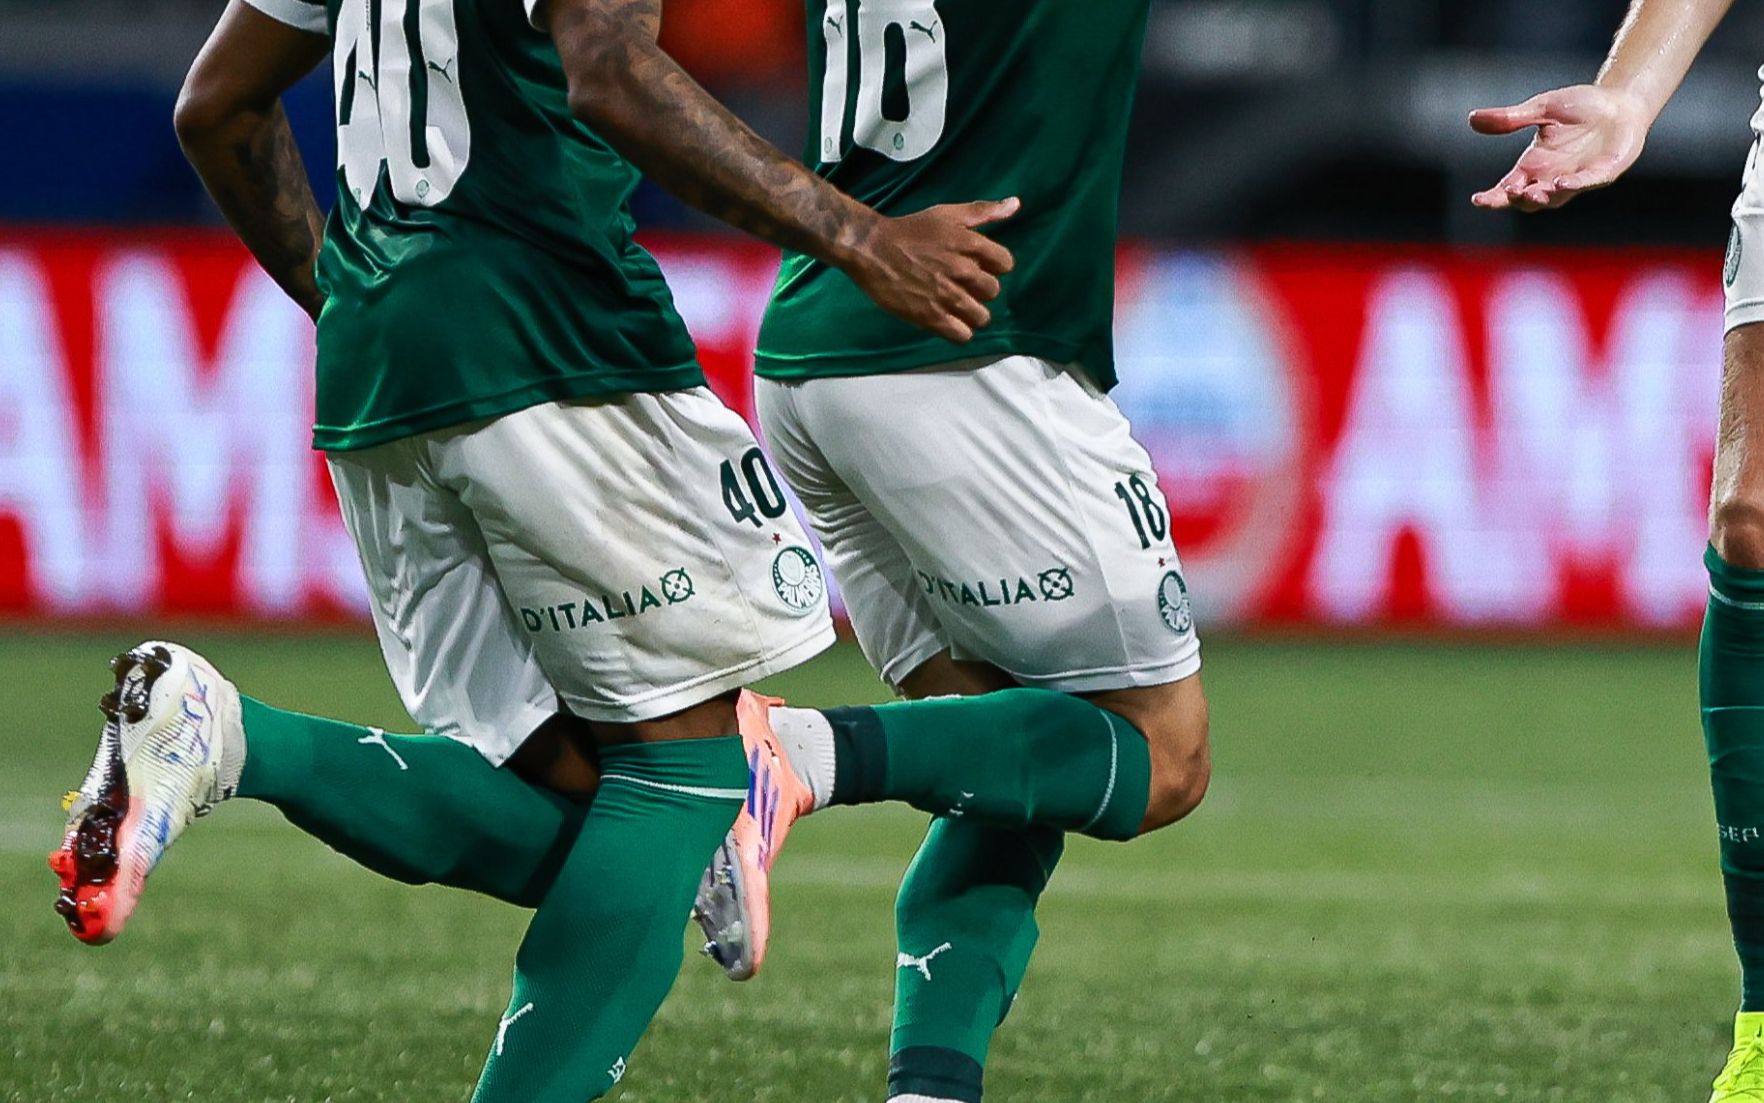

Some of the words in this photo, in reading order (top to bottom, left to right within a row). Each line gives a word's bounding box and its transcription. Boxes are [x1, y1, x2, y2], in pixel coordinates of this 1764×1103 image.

[720, 447, 787, 528] 40
[1115, 472, 1165, 550] 18
[521, 585, 661, 633] D'ITALIA
